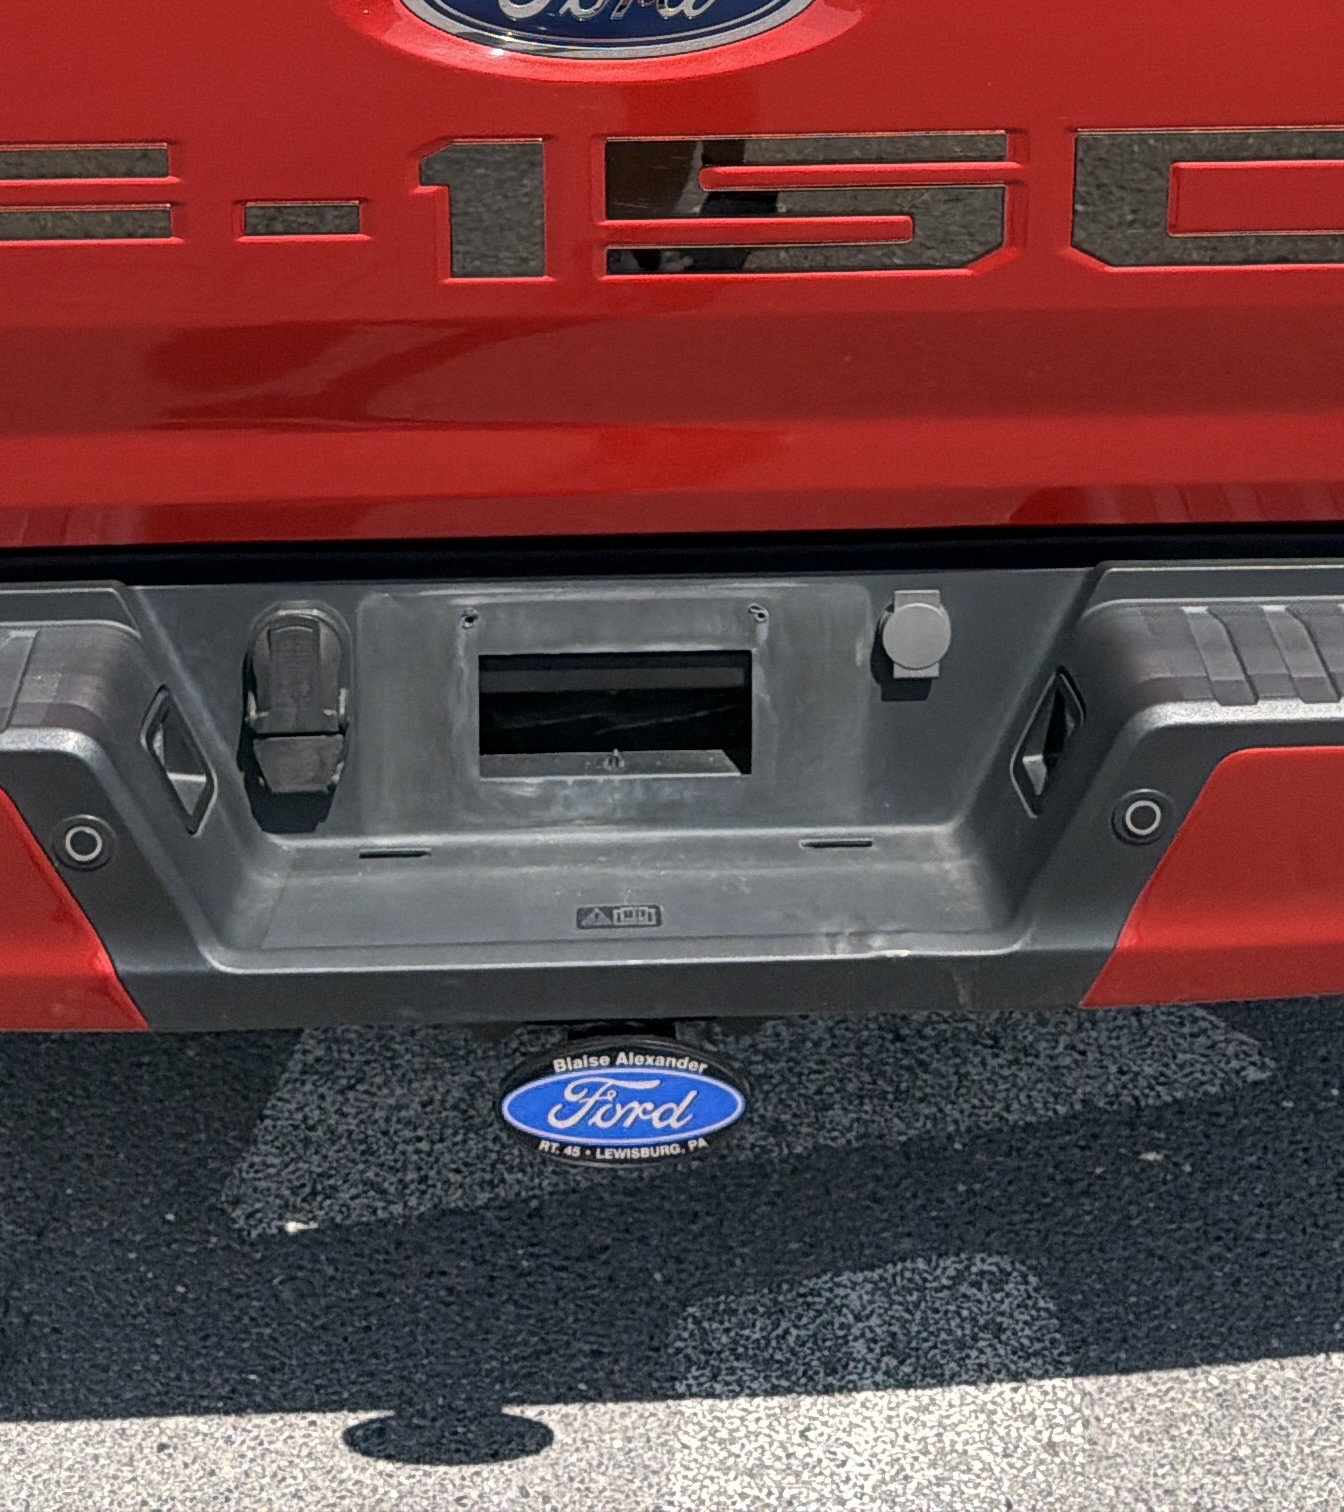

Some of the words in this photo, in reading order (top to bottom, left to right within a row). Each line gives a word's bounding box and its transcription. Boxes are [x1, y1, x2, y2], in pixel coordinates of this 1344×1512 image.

[553, 1052, 610, 1073] Blaise
[615, 1051, 709, 1074] Alexander
[547, 1077, 698, 1129] Ford
[539, 1139, 560, 1155] RT.
[564, 1146, 581, 1158] 45
[688, 1138, 709, 1152] PA
